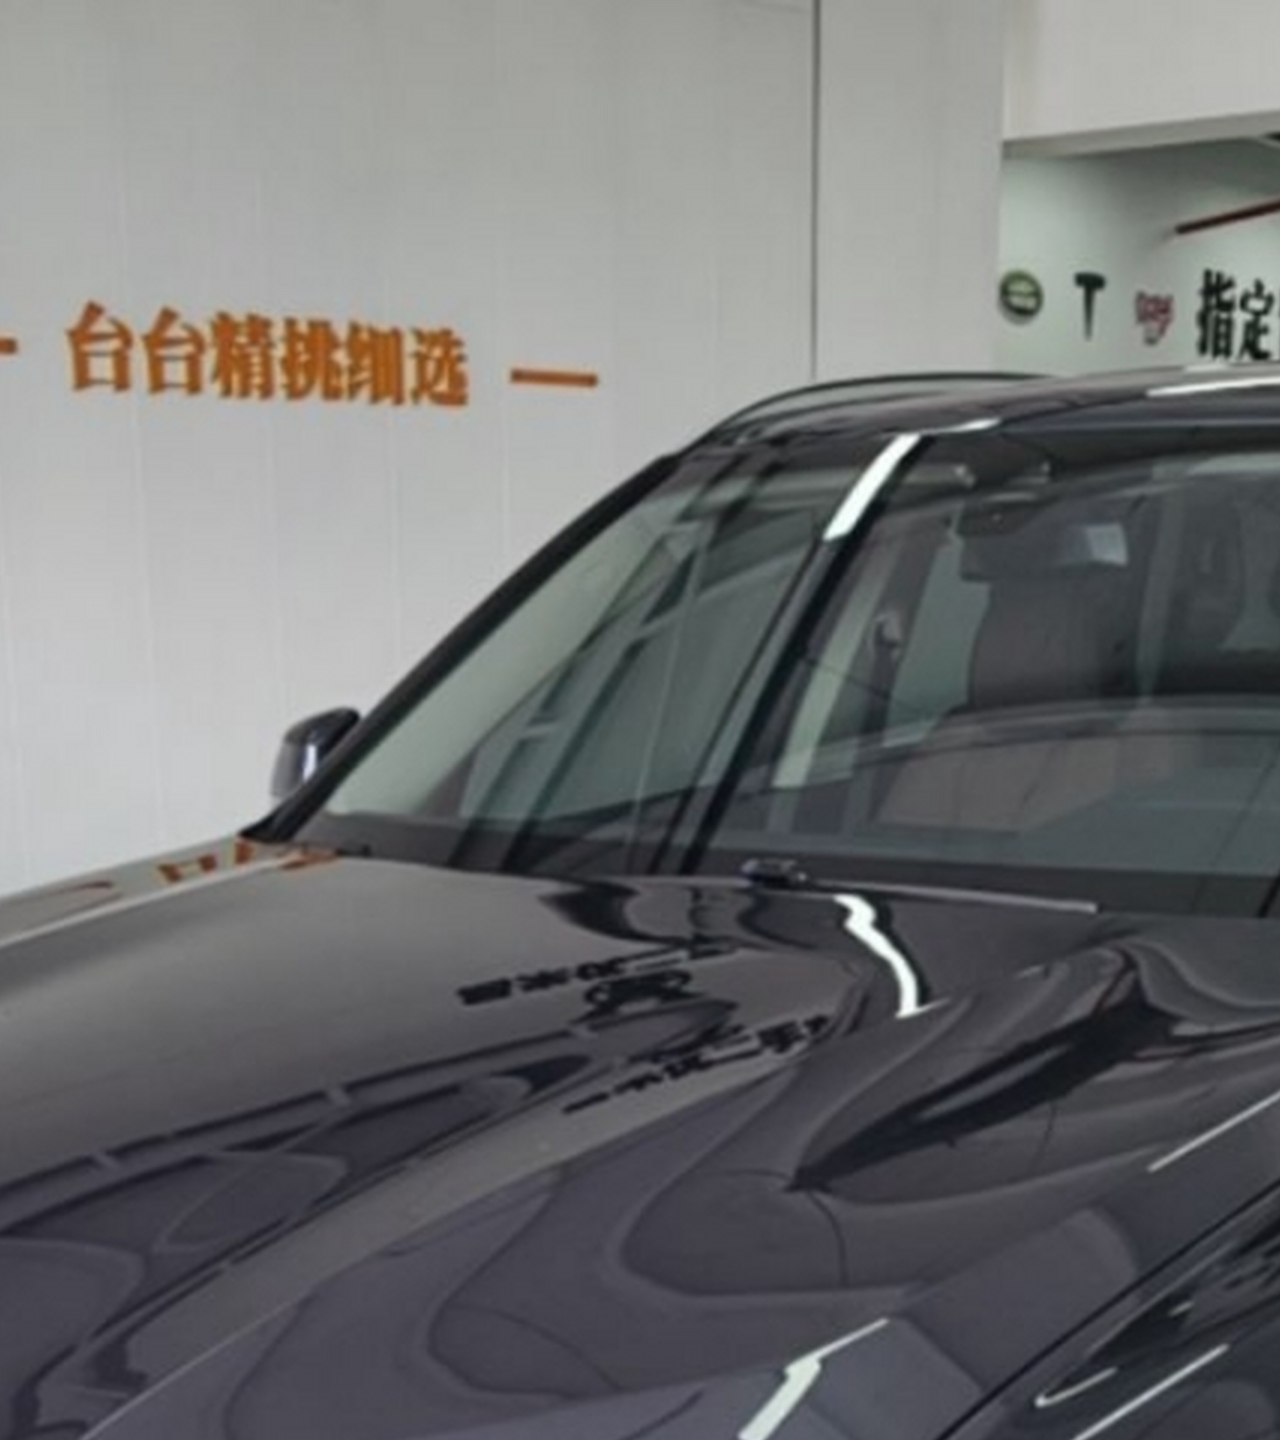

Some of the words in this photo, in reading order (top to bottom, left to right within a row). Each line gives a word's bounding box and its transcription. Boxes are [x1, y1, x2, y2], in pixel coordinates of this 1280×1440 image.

[65, 300, 468, 407] 台台精挑细选
